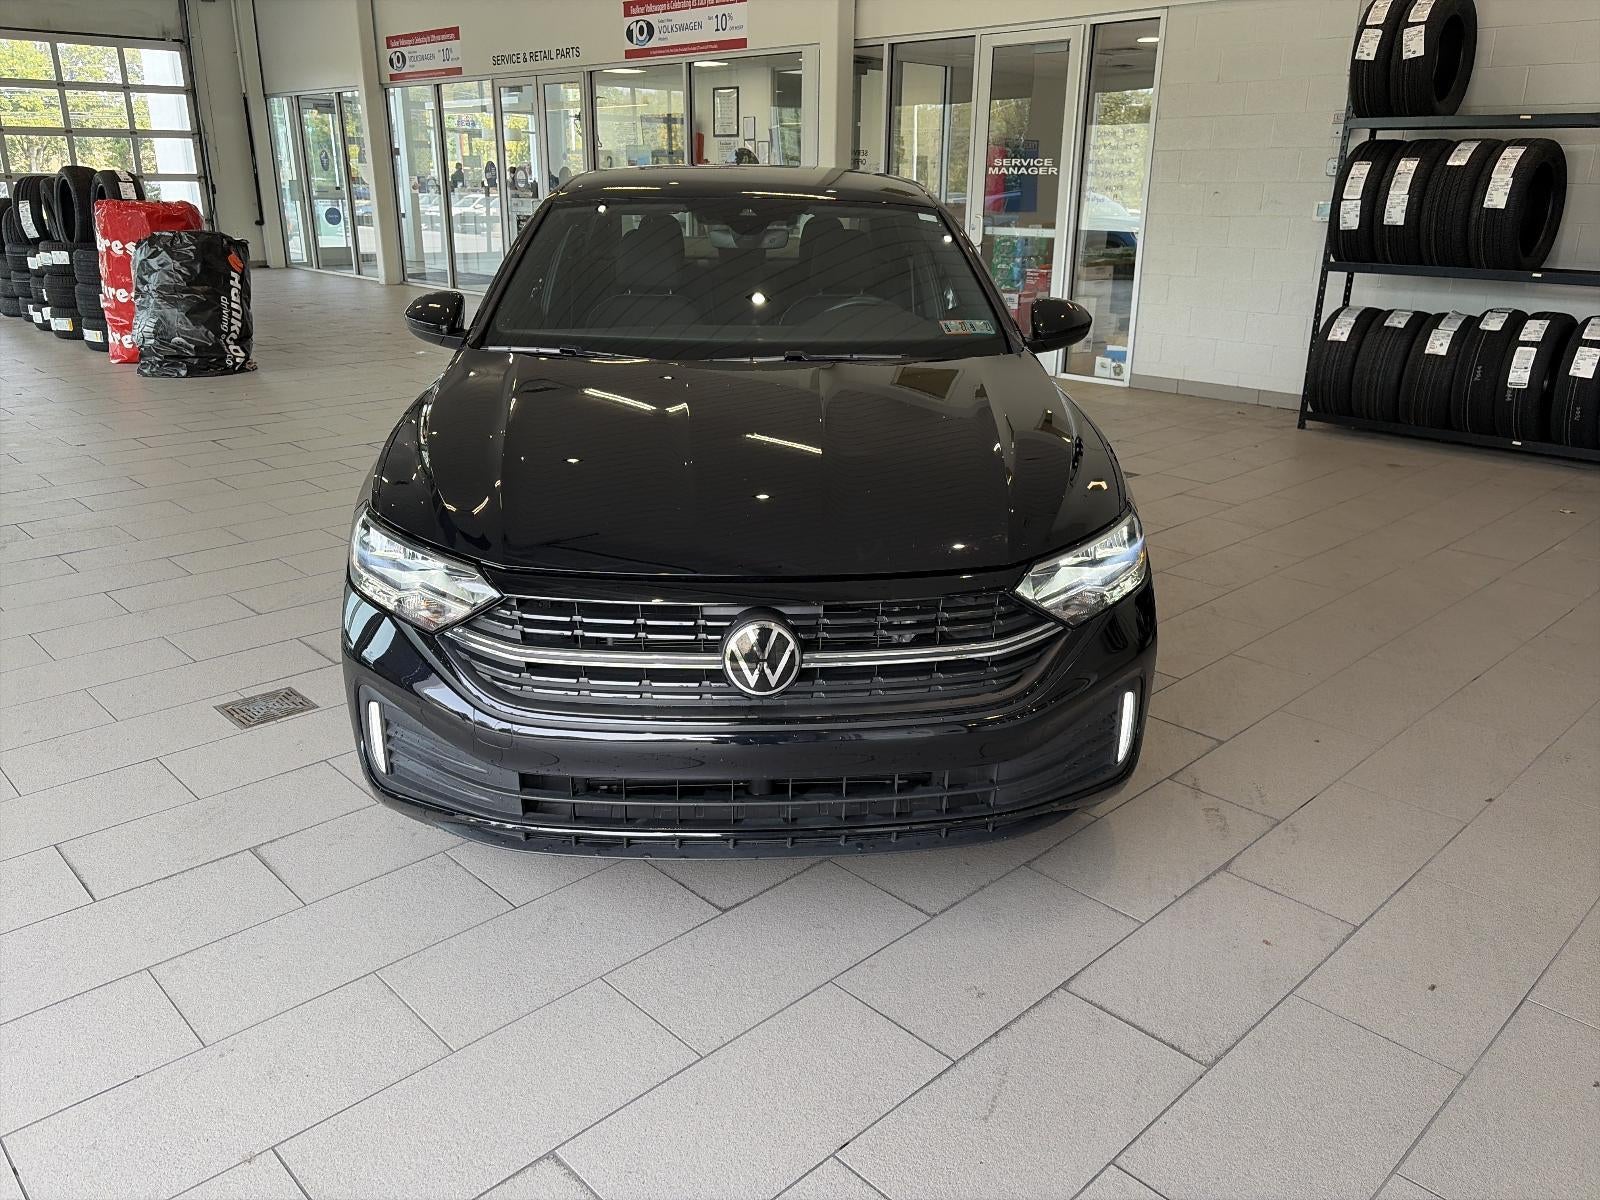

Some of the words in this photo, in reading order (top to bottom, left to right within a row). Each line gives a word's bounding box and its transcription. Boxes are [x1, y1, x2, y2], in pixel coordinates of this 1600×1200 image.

[658, 21, 703, 34] VOLKSWAGEN
[492, 52, 521, 66] SERVICE
[522, 52, 528, 63] &
[529, 50, 554, 62] RETAIL
[556, 46, 580, 60] PARTS
[994, 158, 1054, 167] SERVICE
[988, 166, 1058, 176] MANAGER
[220, 296, 230, 332] driving
[726, 622, 799, 693] VW
